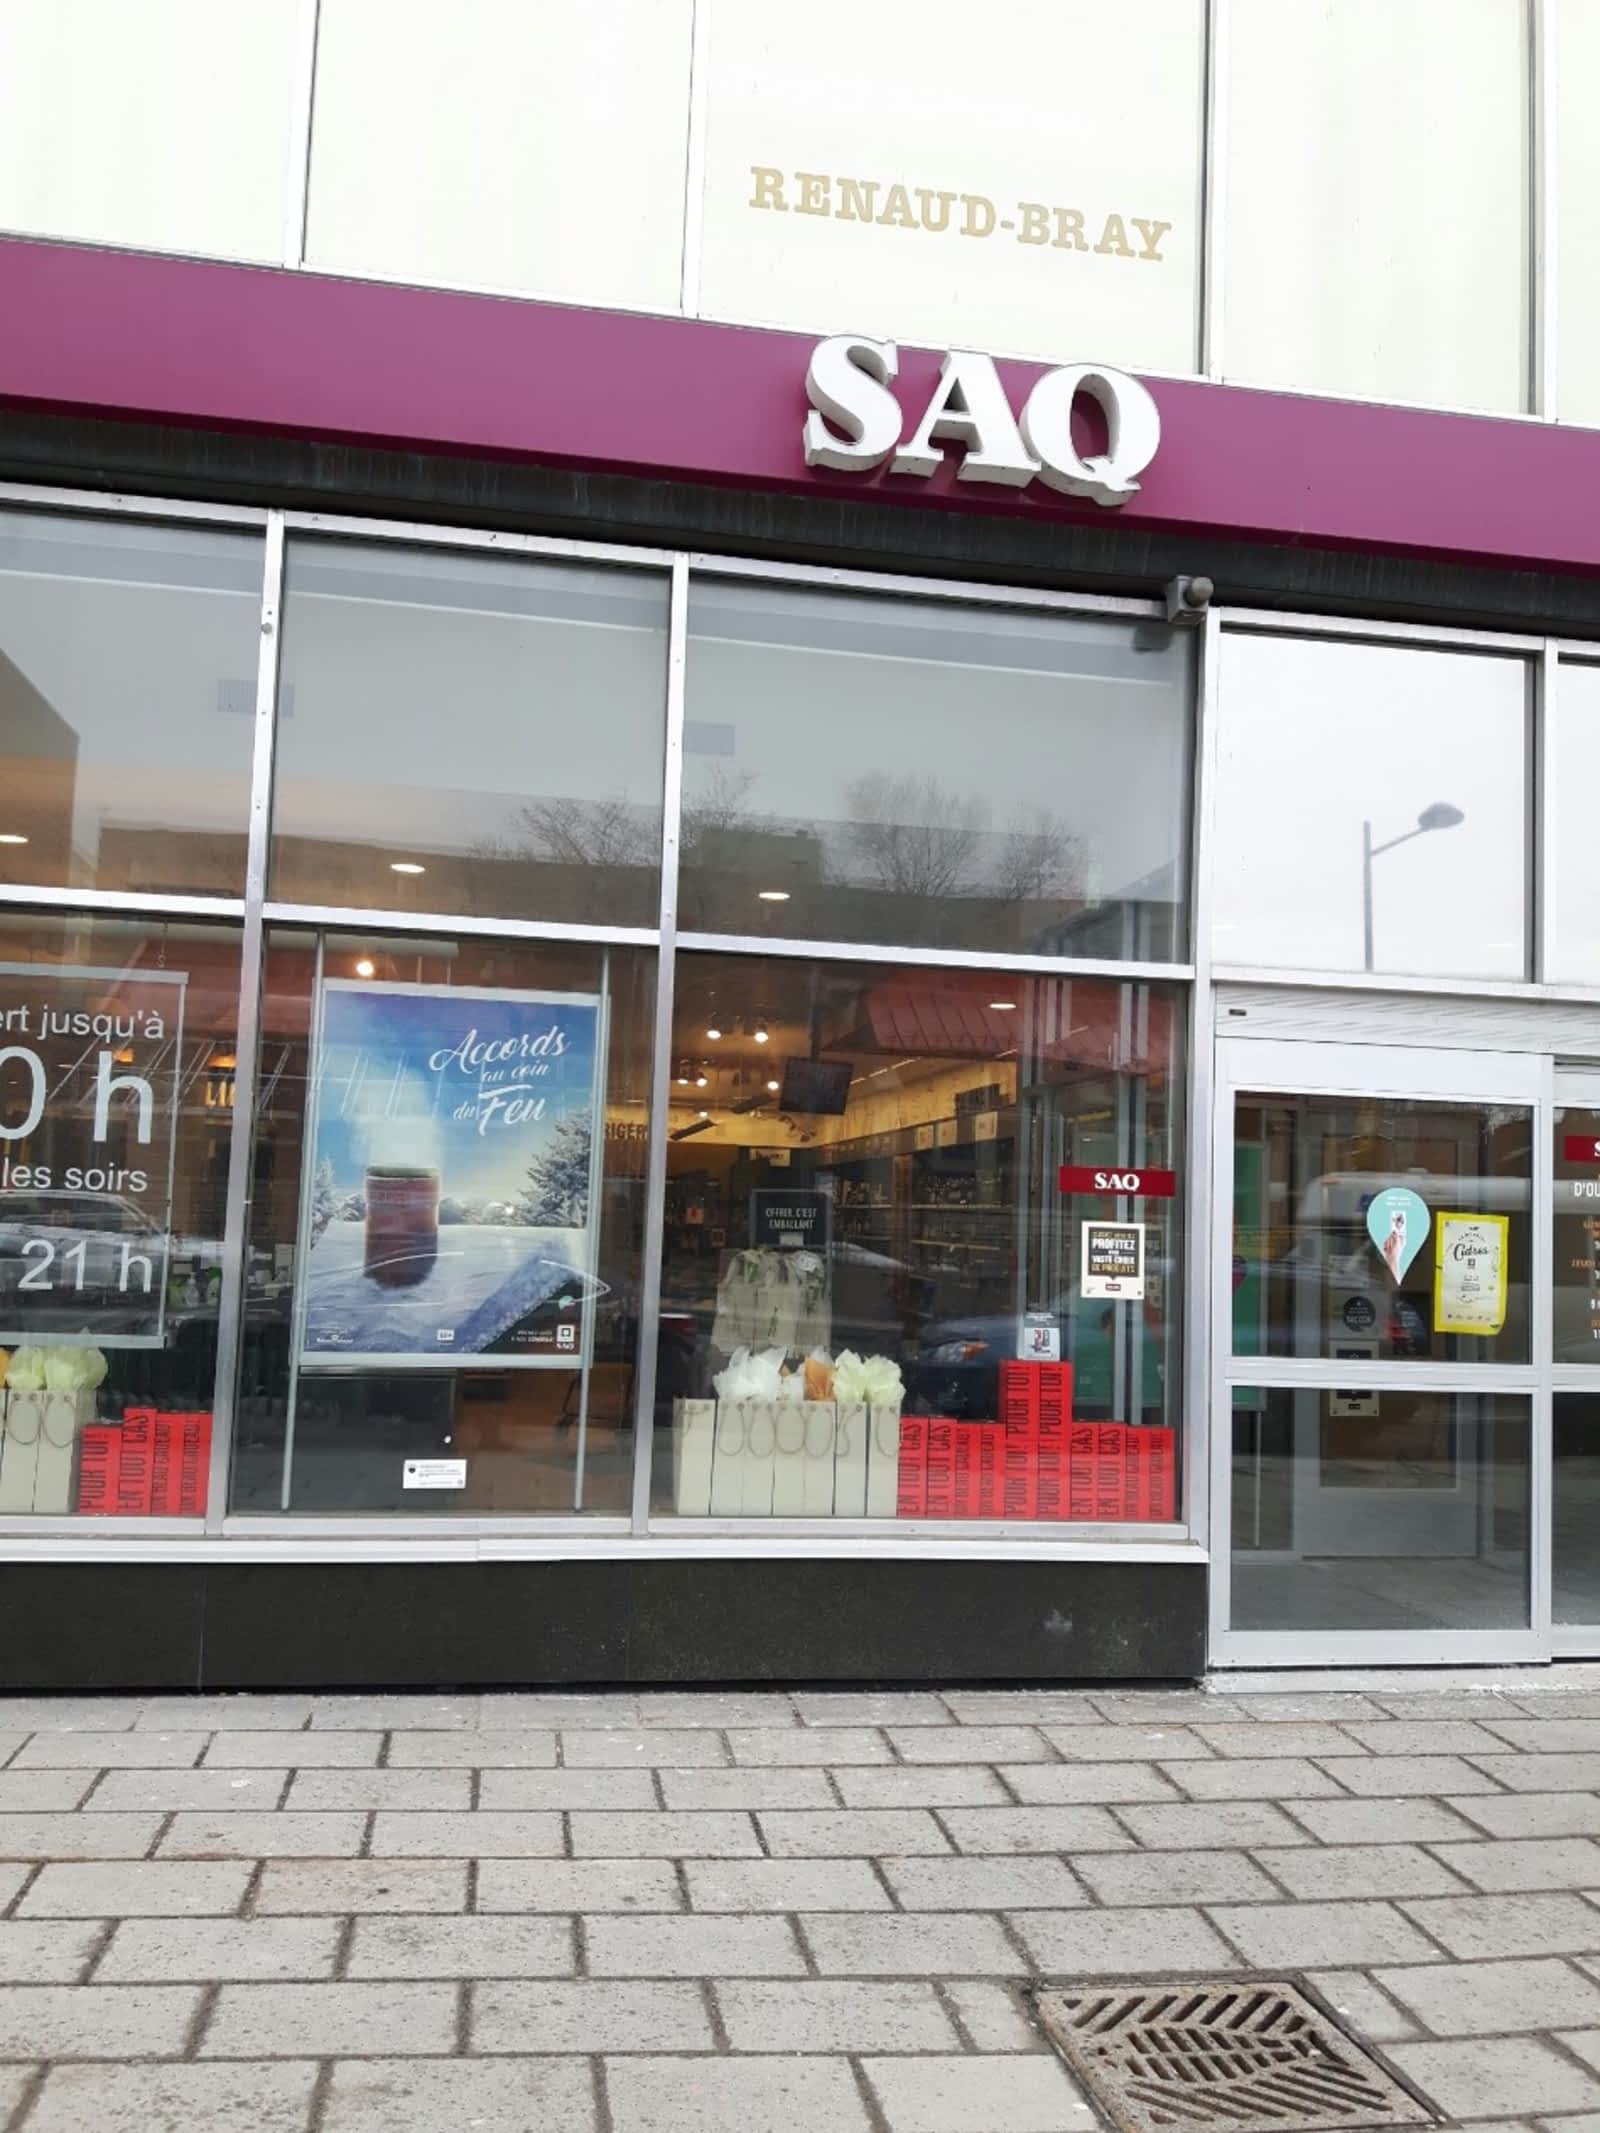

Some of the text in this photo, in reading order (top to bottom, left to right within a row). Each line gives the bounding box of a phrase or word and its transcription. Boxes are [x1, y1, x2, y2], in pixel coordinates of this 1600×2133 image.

[749, 166, 1171, 261] RENAUD-BRAY
[802, 334, 1161, 507] SAQ
[0, 1004, 165, 1043] rt jusqu'à
[429, 1026, 571, 1073] Accords
[511, 1059, 549, 1080] coin
[93, 1051, 153, 1144] h
[453, 1084, 546, 1136] du Feu
[3, 1157, 148, 1192] les soirs
[1094, 1172, 1140, 1191] SAQ
[18, 1240, 153, 1293] 21 h
[1091, 1238, 1136, 1250] PROFITEZ
